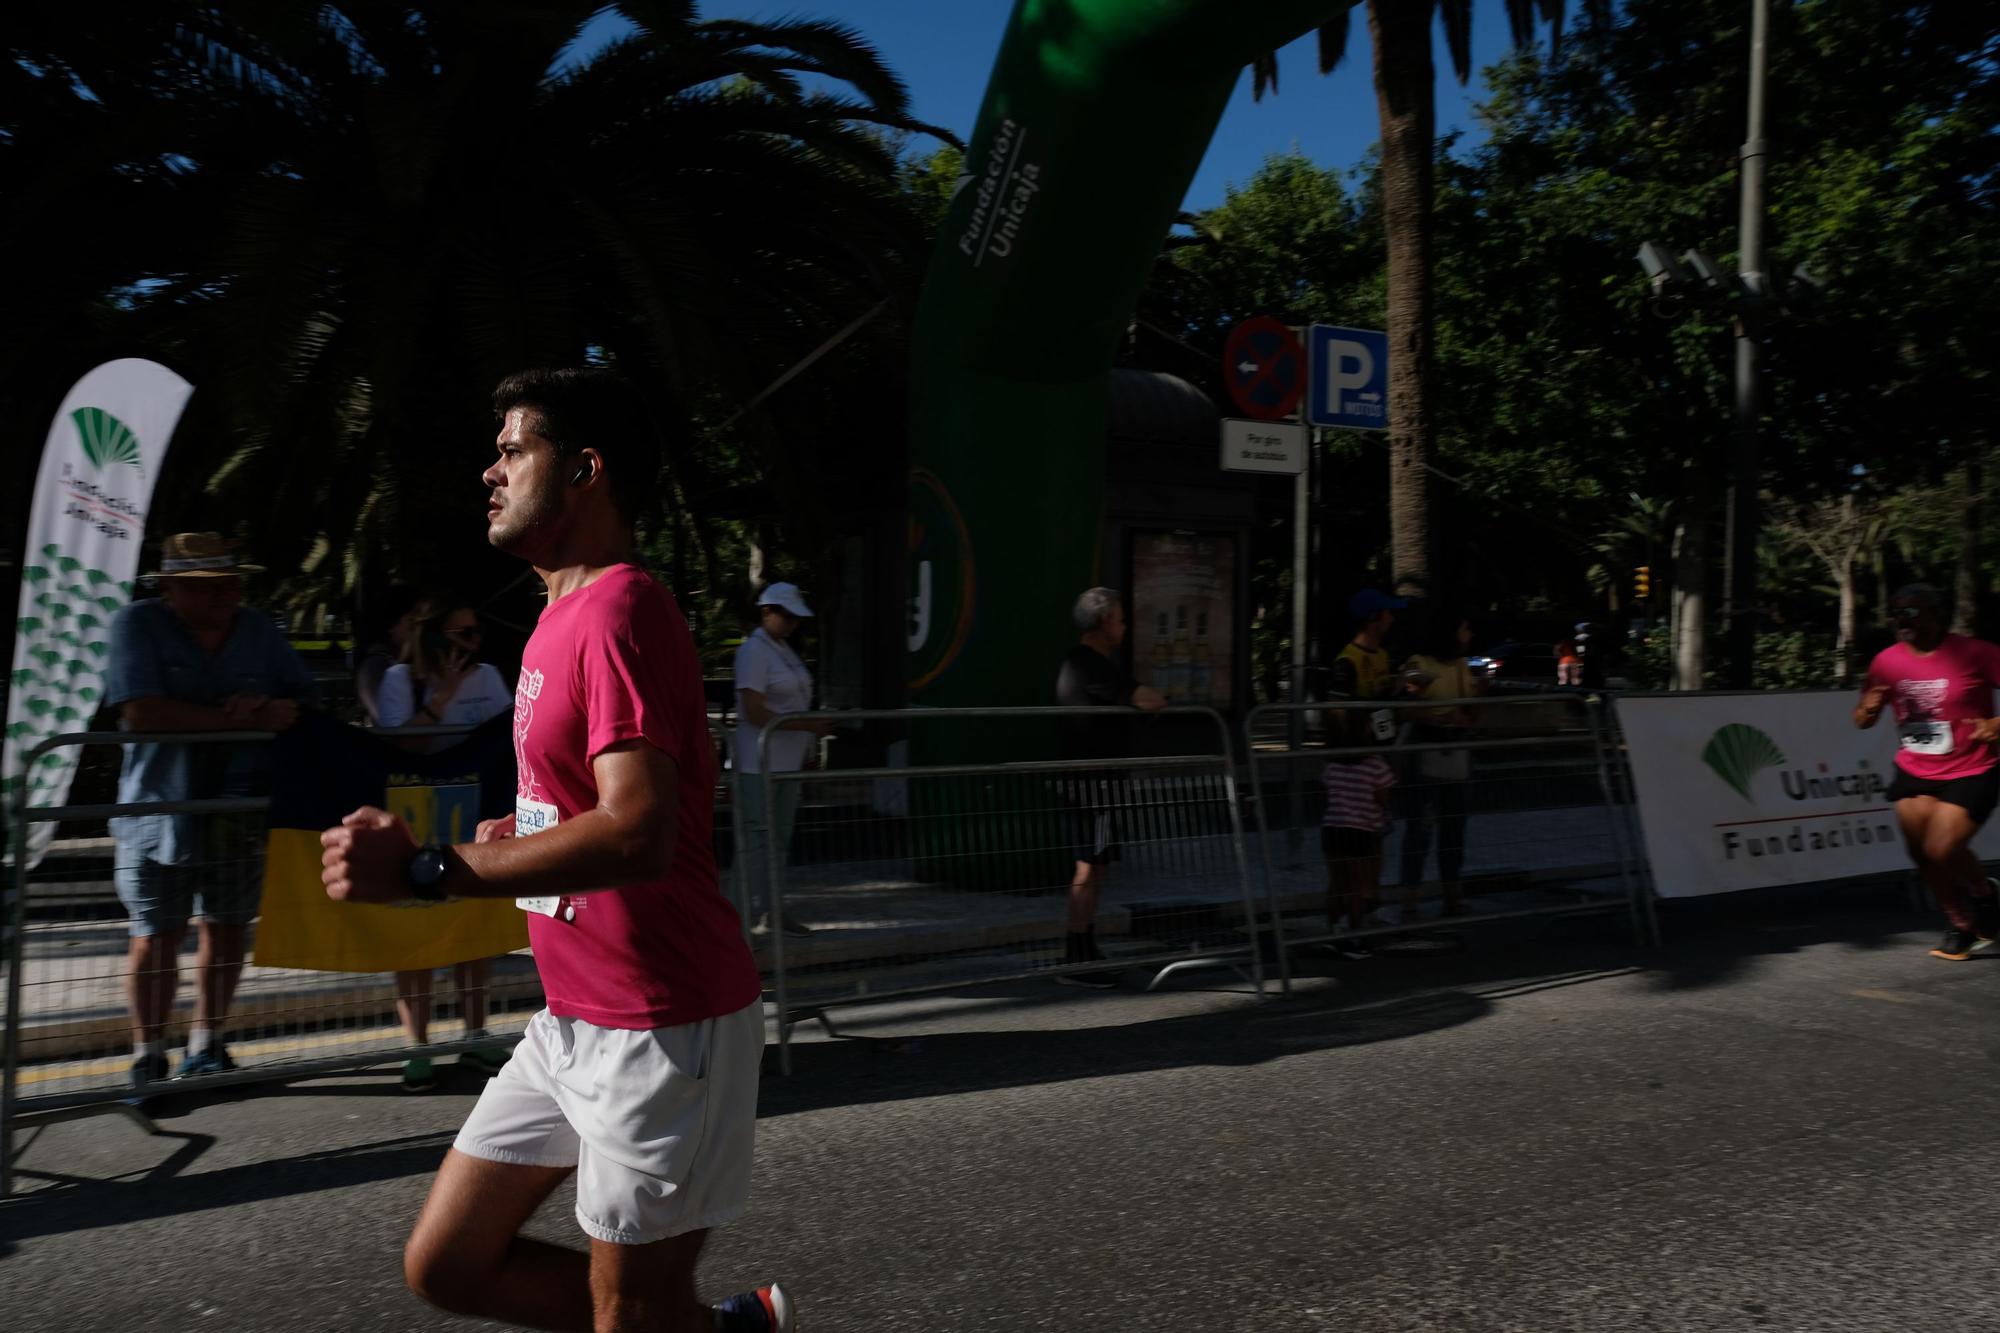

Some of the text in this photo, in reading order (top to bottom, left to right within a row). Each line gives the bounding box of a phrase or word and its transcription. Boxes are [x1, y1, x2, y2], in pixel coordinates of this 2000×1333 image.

[959, 119, 1016, 256] Fundación
[989, 162, 1040, 258] Unicaja
[1326, 338, 1375, 414] P
[1780, 760, 1889, 803] Unicaja
[1721, 819, 1896, 860] Fundación
